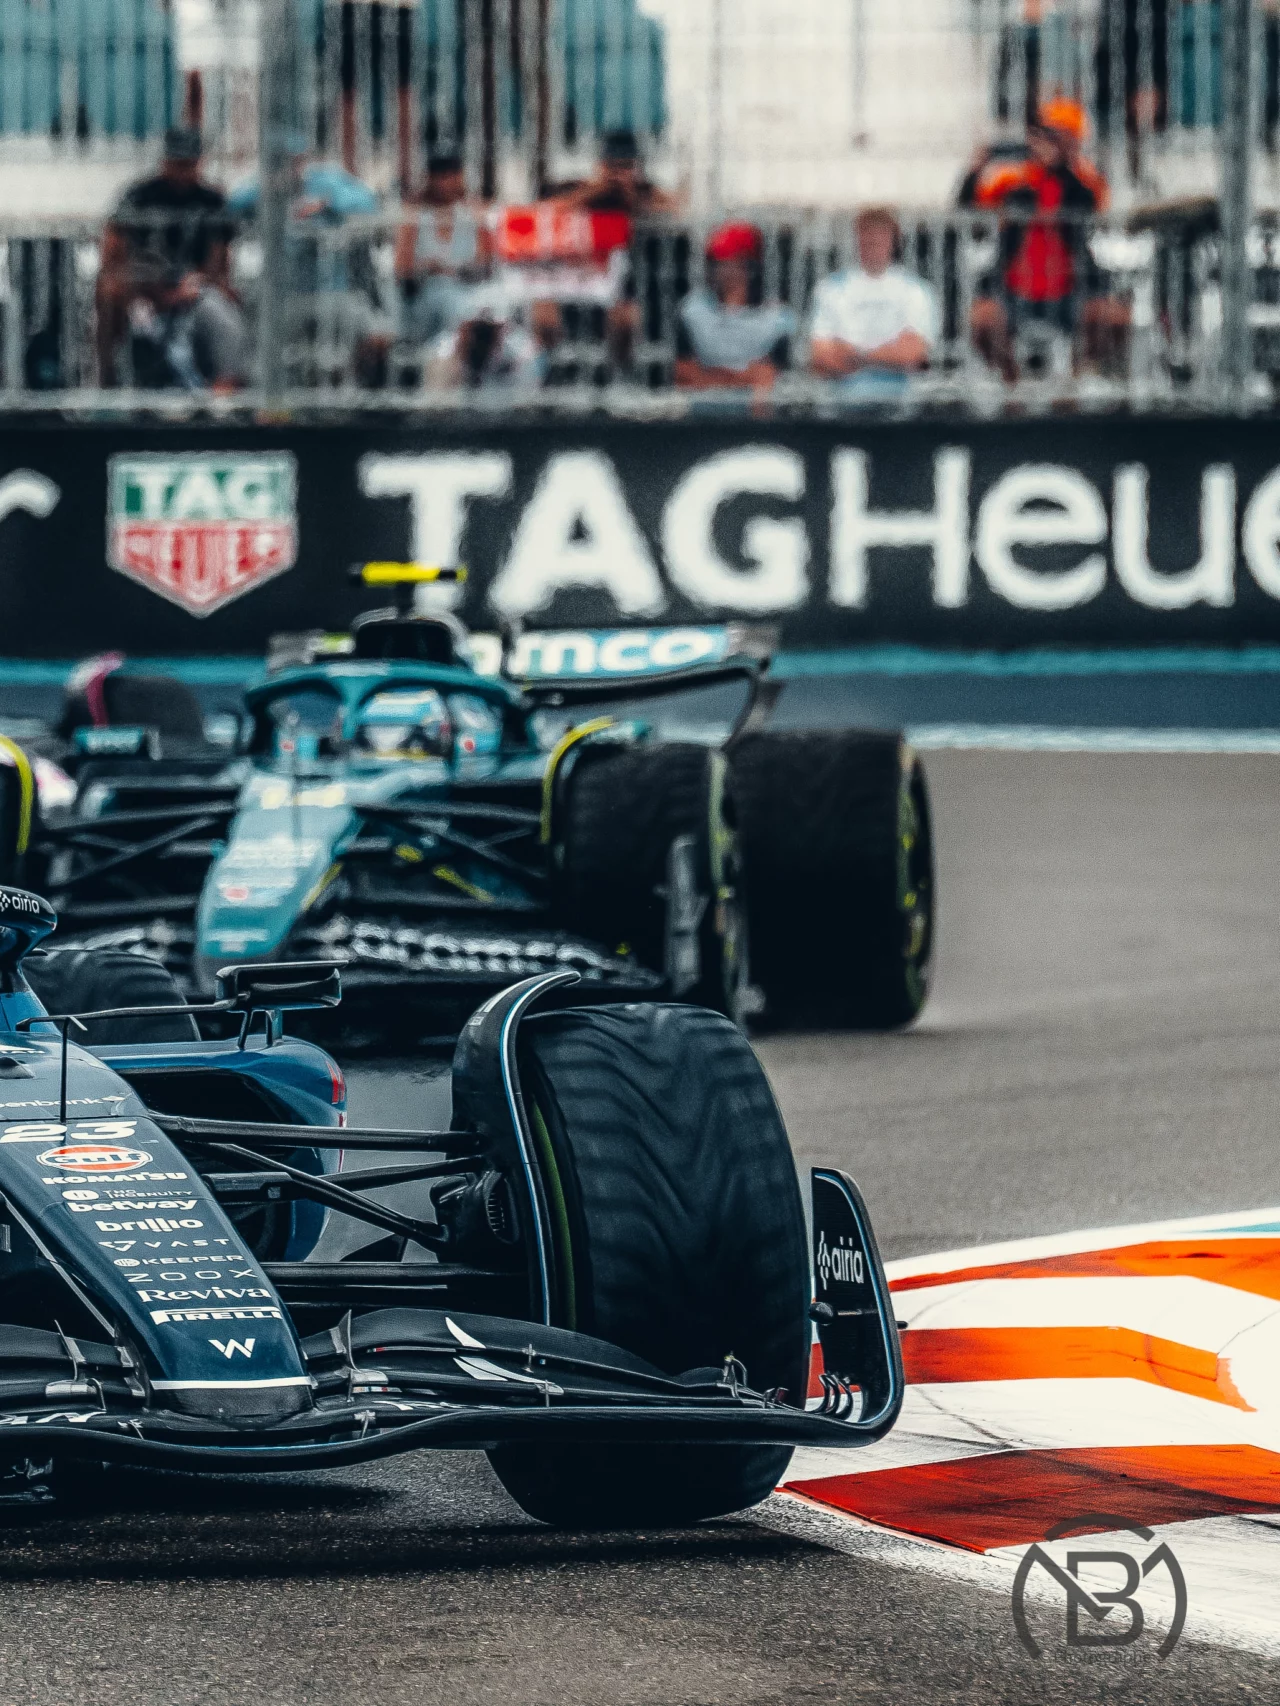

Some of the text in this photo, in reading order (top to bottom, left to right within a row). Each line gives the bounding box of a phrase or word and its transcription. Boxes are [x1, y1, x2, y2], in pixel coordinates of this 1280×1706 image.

[130, 464, 270, 519] TAG
[11, 894, 40, 914] airia
[0, 1121, 138, 1144] 23
[46, 1153, 143, 1164] Gulf
[41, 1171, 188, 1185] KOMATSU
[67, 1200, 198, 1212] betway
[94, 1218, 204, 1232] brillio
[143, 1238, 230, 1248] VAST
[141, 1254, 245, 1265] KEEPER
[831, 1236, 865, 1285] airia
[123, 1268, 259, 1283] ZOOX
[135, 1286, 273, 1302] Reviva
[149, 1306, 284, 1325] PIRELLI
